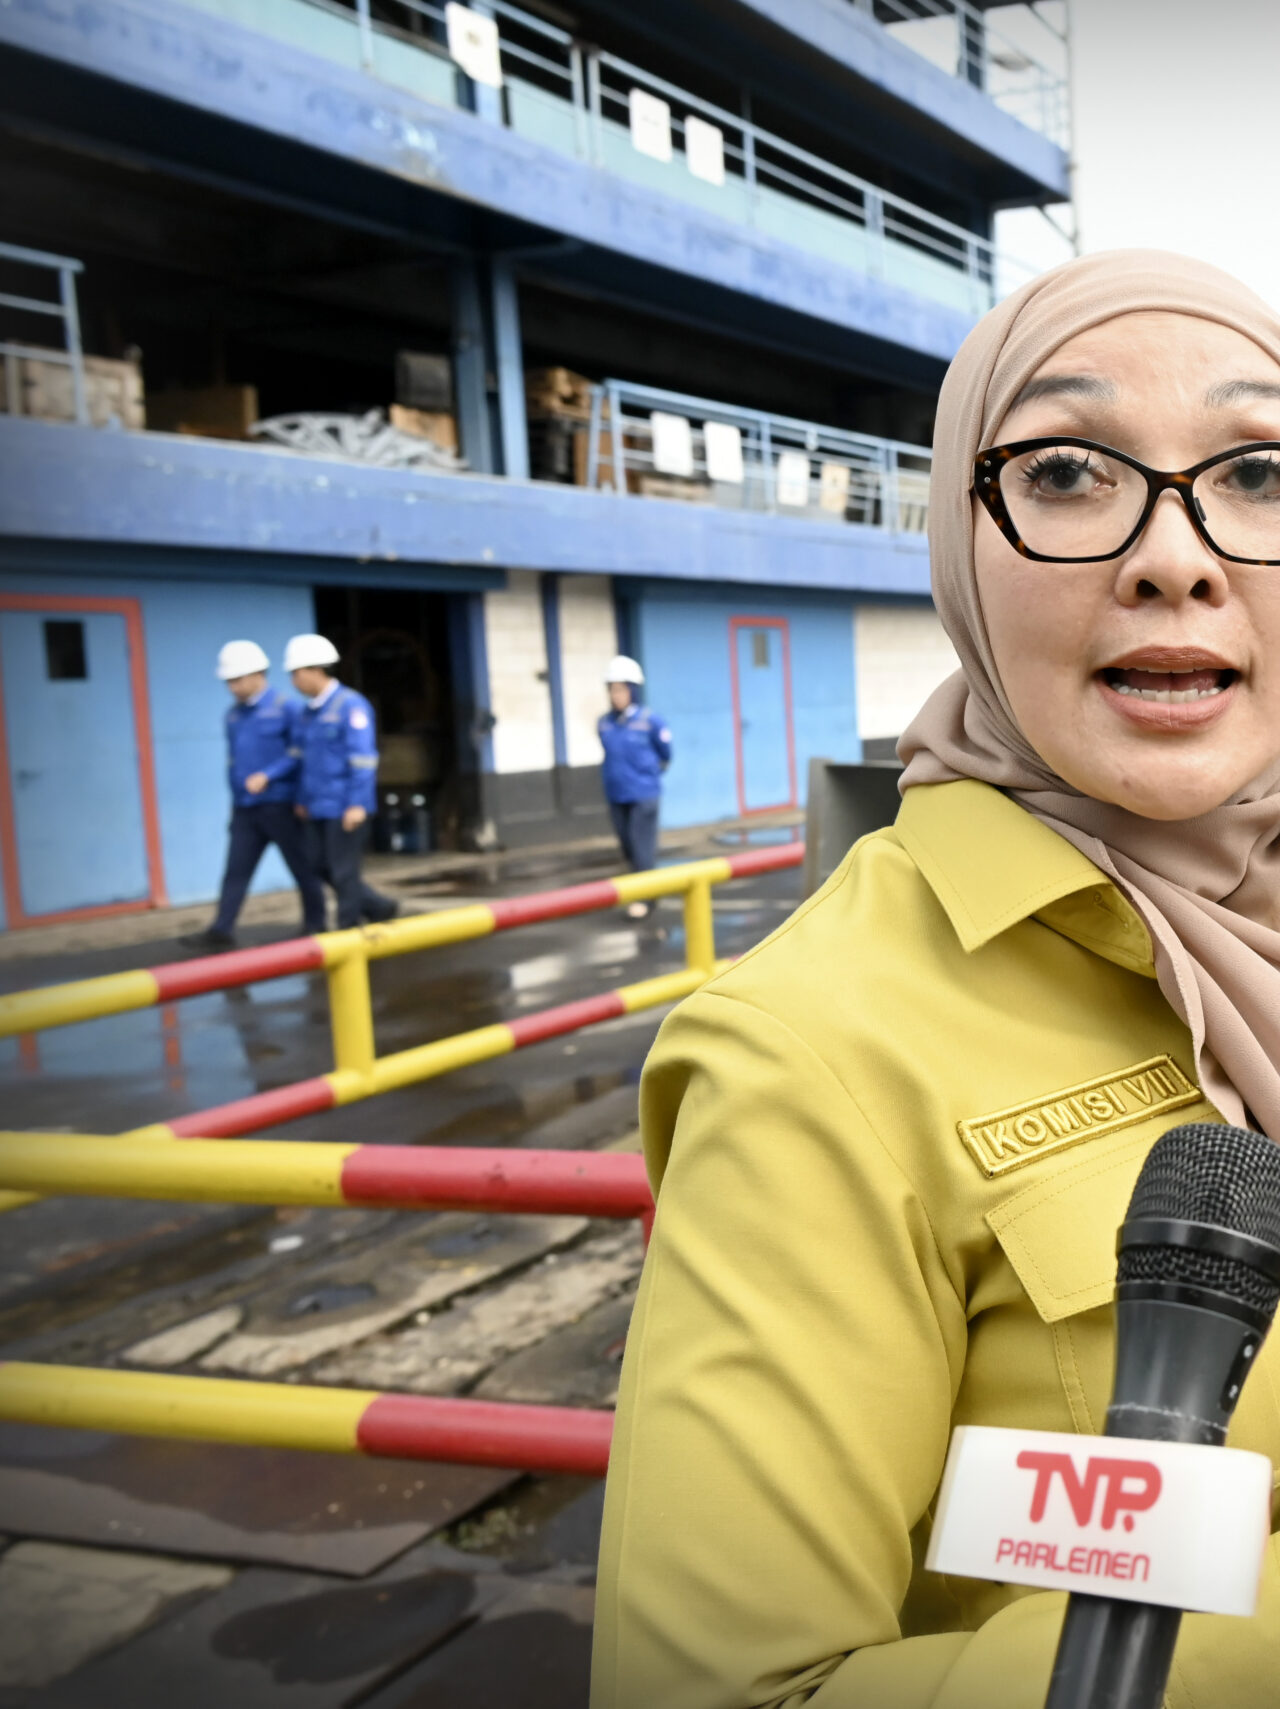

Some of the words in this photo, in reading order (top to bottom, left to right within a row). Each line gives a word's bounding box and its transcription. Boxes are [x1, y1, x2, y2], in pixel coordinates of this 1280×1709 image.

[982, 1085, 1126, 1158] KOMISI
[1123, 1068, 1177, 1104] VII
[996, 1538, 1151, 1582] PARLEMEN
